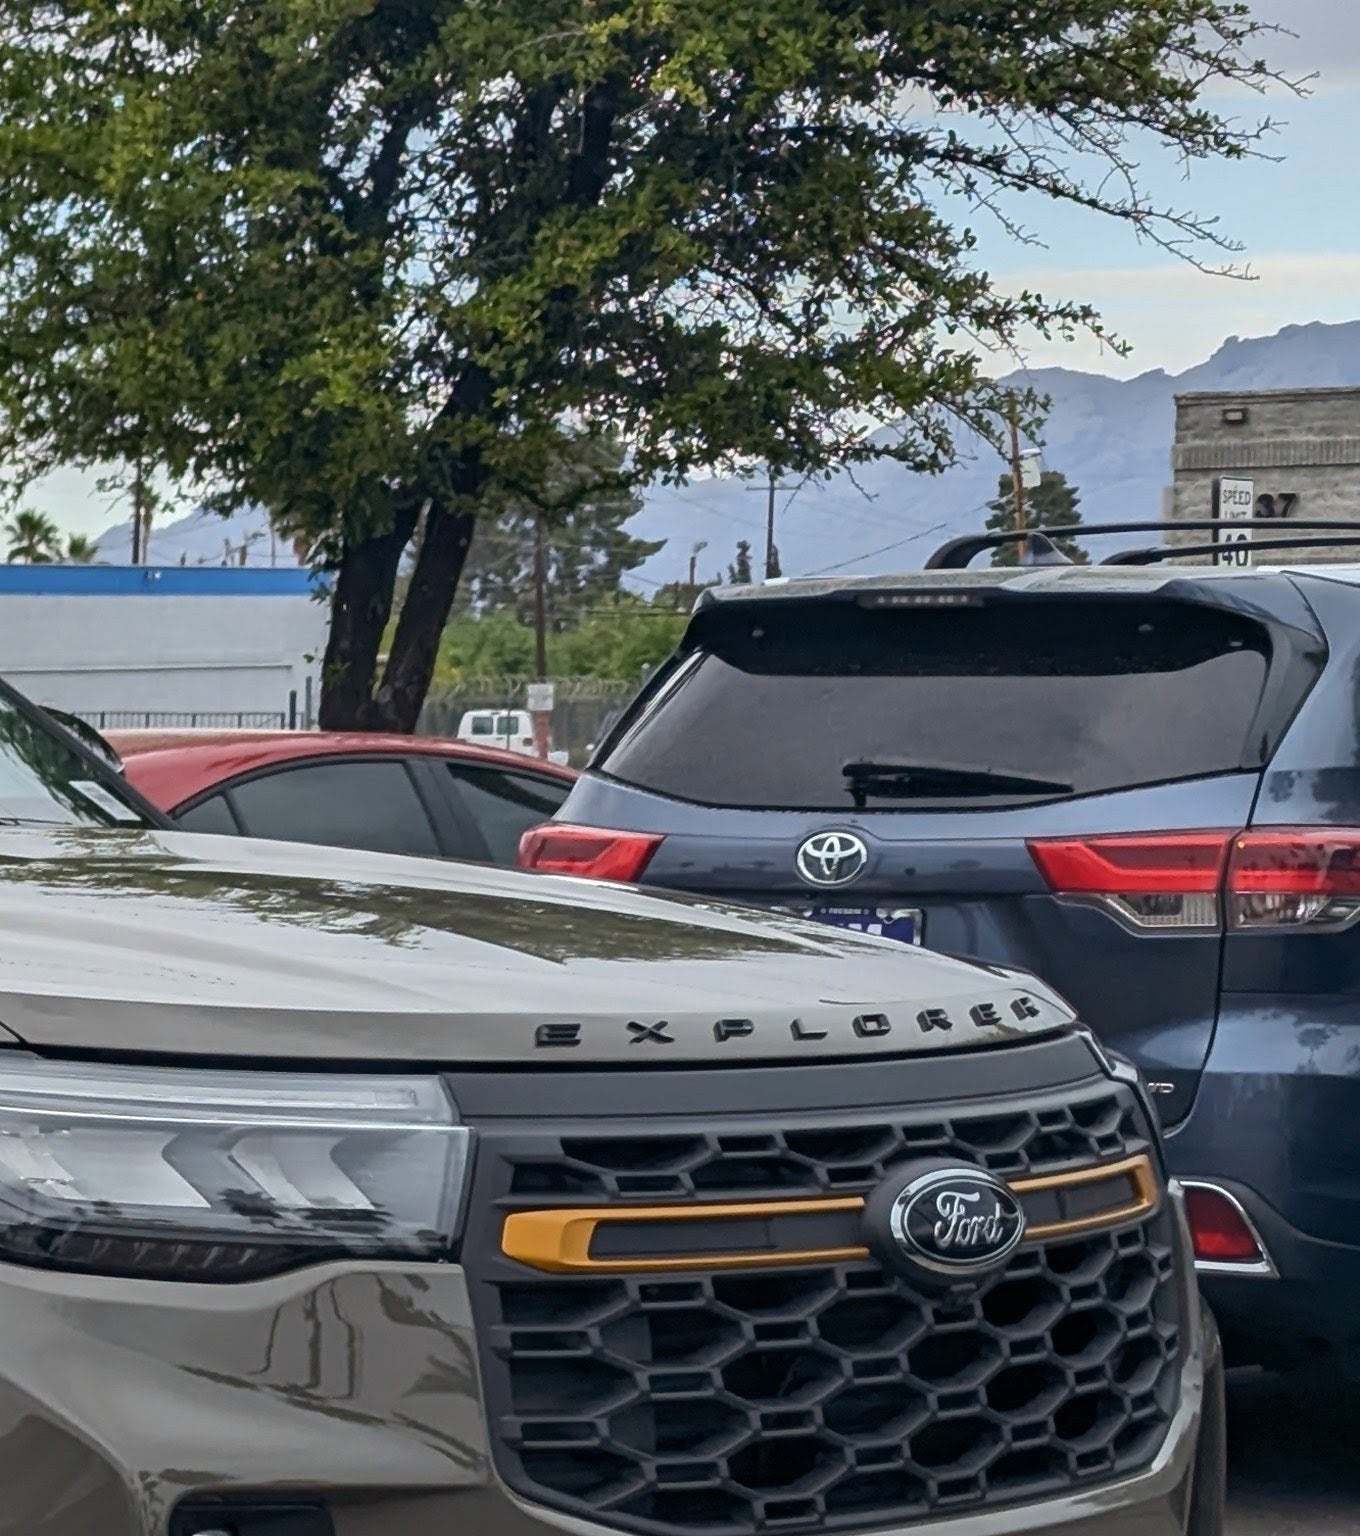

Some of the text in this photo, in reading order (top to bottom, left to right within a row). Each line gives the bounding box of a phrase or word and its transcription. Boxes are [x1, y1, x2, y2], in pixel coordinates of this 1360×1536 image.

[1223, 489, 1251, 505] SPEED
[1222, 533, 1248, 566] 40
[534, 996, 1041, 1048] EXPLORER
[934, 1191, 1004, 1249] Ford
